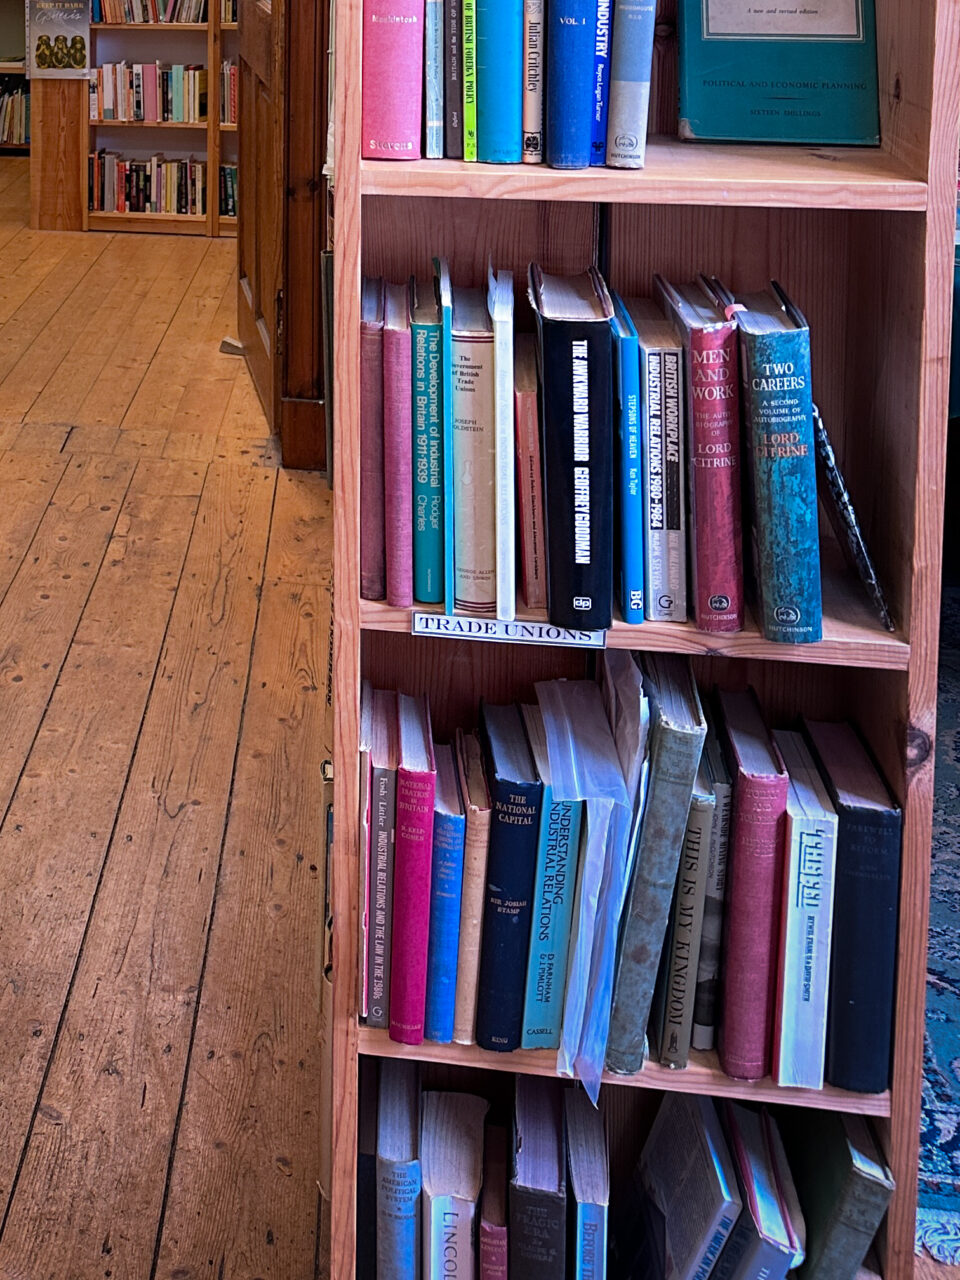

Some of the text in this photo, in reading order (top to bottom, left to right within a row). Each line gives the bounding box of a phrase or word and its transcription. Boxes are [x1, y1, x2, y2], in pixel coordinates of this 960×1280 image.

[527, 20, 540, 93] Julian Critchley
[763, 363, 794, 375] TWO
[752, 376, 805, 391] CAREERS
[763, 433, 799, 444] LORD
[572, 340, 591, 564] THE AWKWARD WARRIOR GEOFFREY GOODMAN
[755, 445, 808, 458] CITRINE
[420, 616, 592, 642] TRADE UNIONS
[510, 795, 526, 804] THE
[496, 802, 536, 815] NATIONAL
[498, 813, 533, 825] CAPITAL
[669, 827, 702, 1025] THIS IS MY KINGDOM
